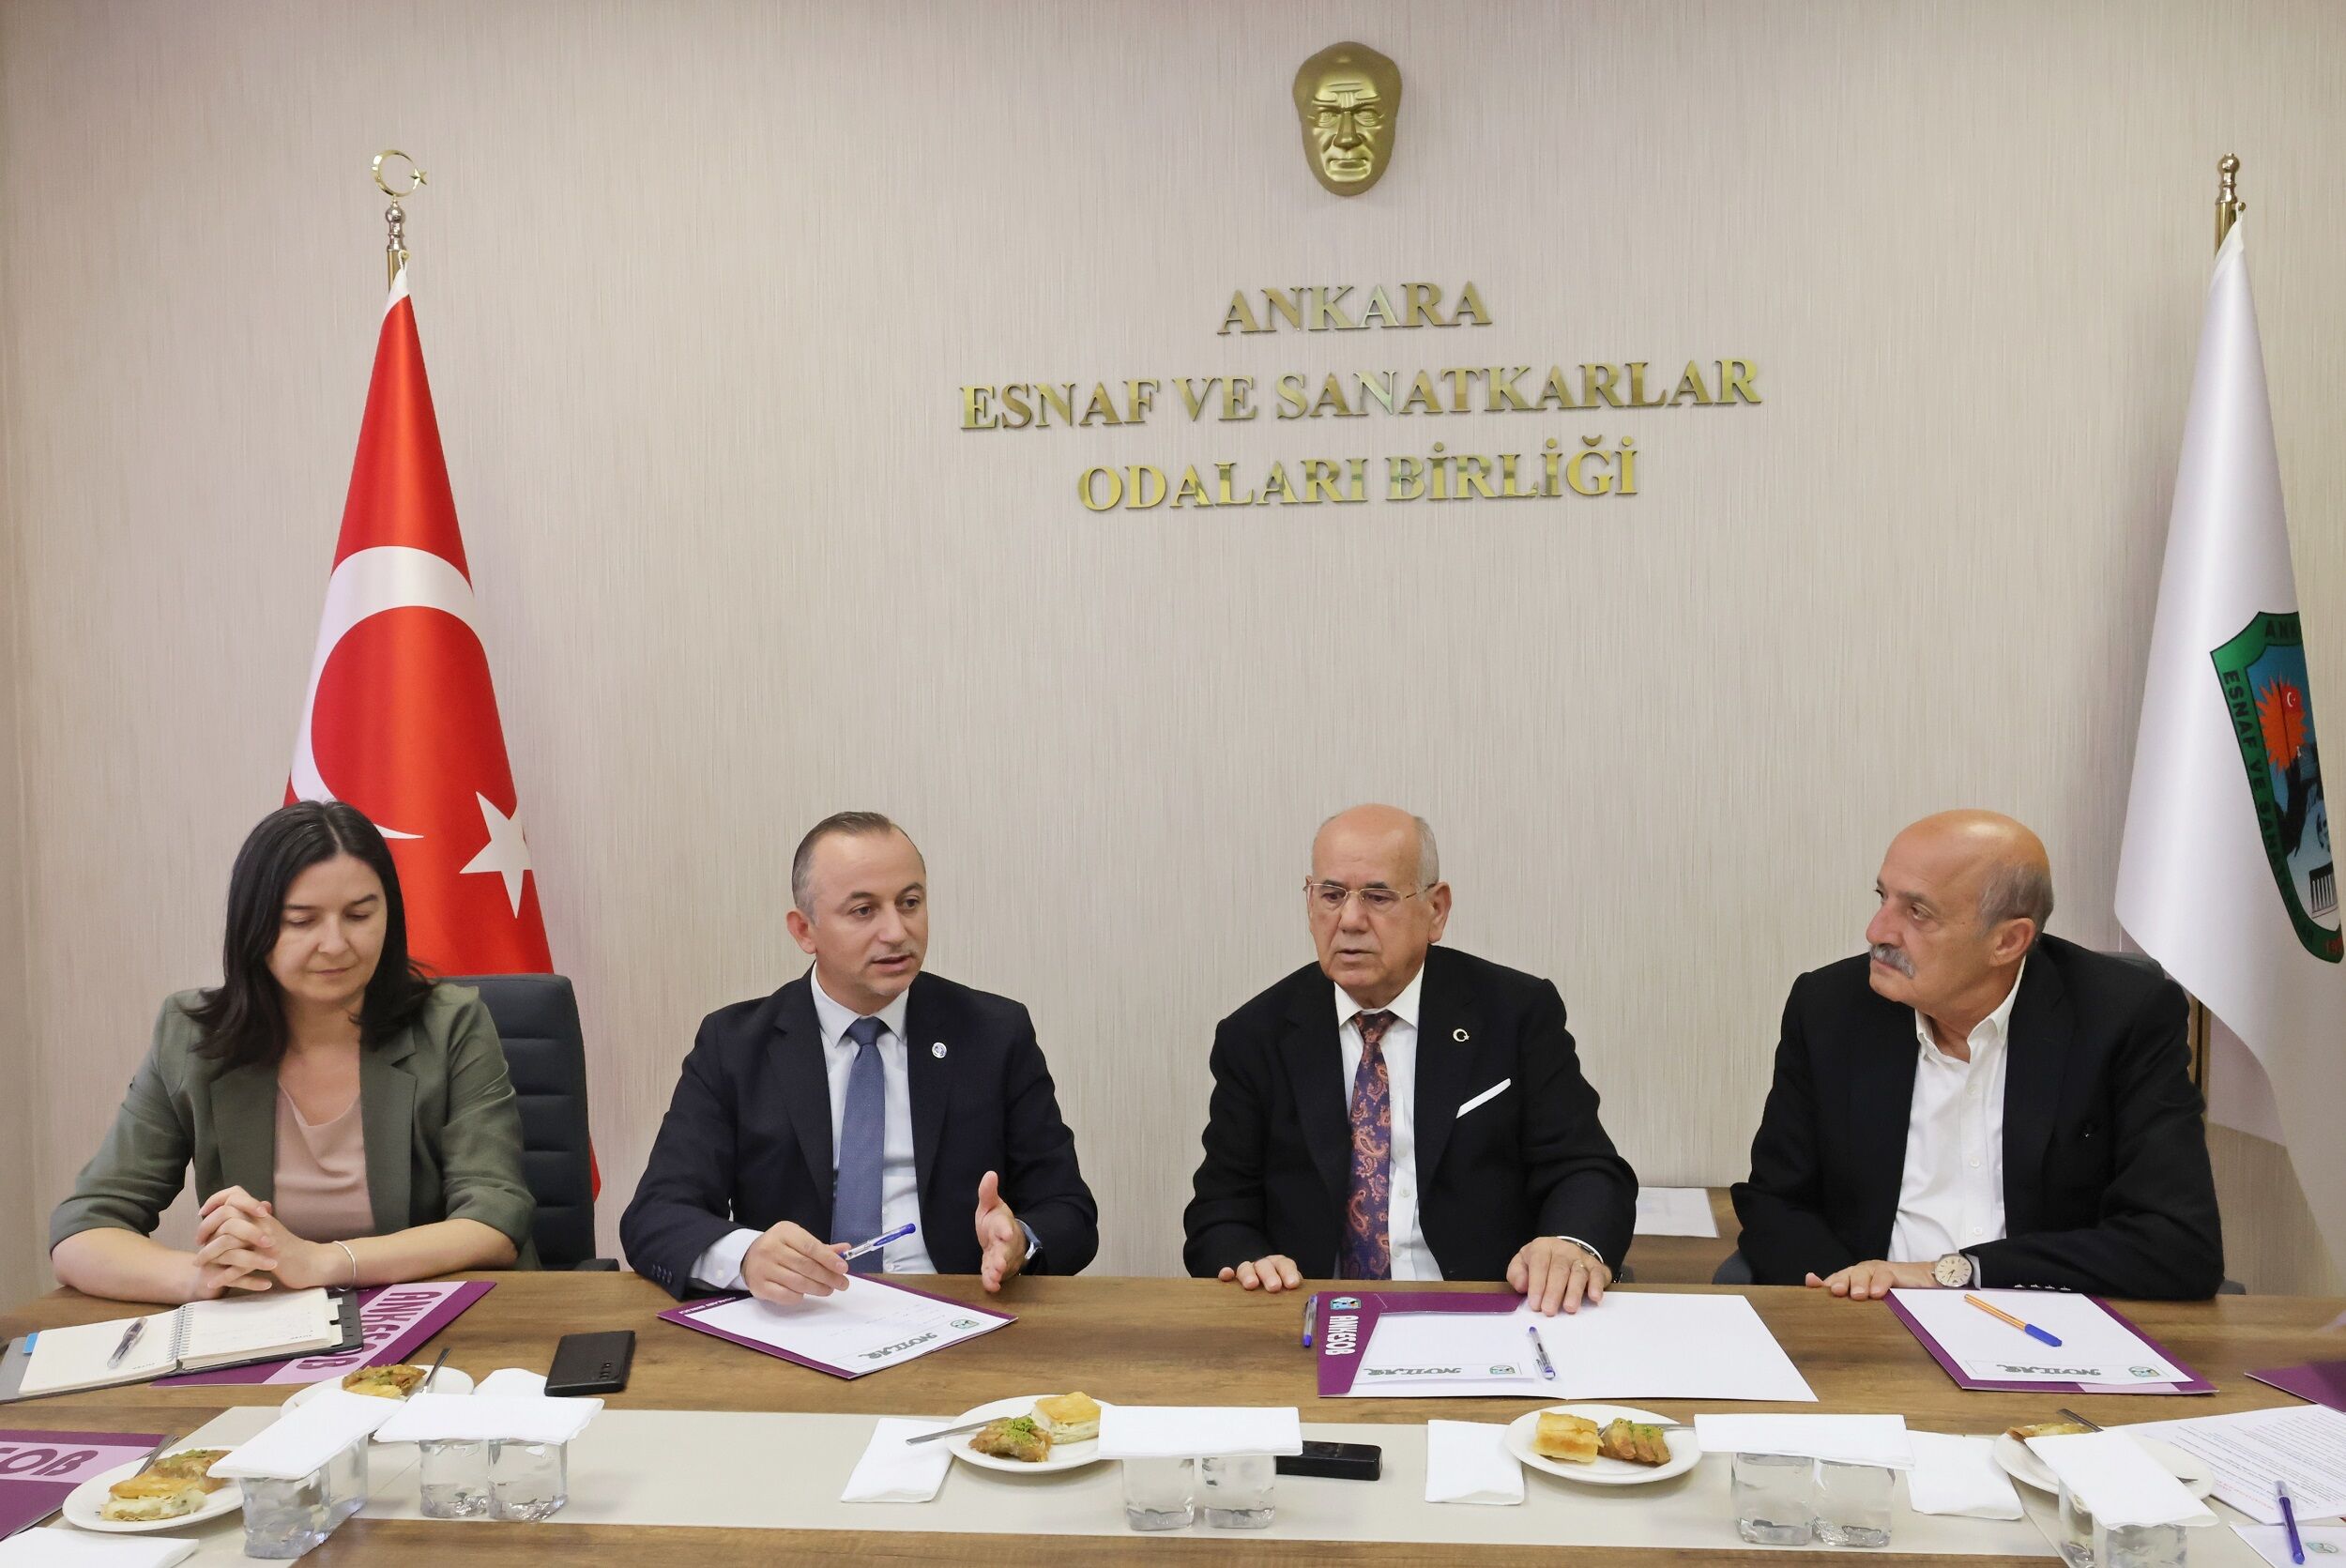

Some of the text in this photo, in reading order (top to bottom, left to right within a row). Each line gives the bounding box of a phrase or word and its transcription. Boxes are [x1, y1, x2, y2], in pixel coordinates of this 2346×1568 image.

[1216, 281, 1493, 336] ANKARA
[959, 358, 1763, 431] ESNAF VE SANATKARLAR
[1076, 434, 1638, 511] ODALARI BİRLİĞİ
[2223, 669, 2257, 748] ESNAF
[1325, 1315, 1359, 1356] ANKESOB
